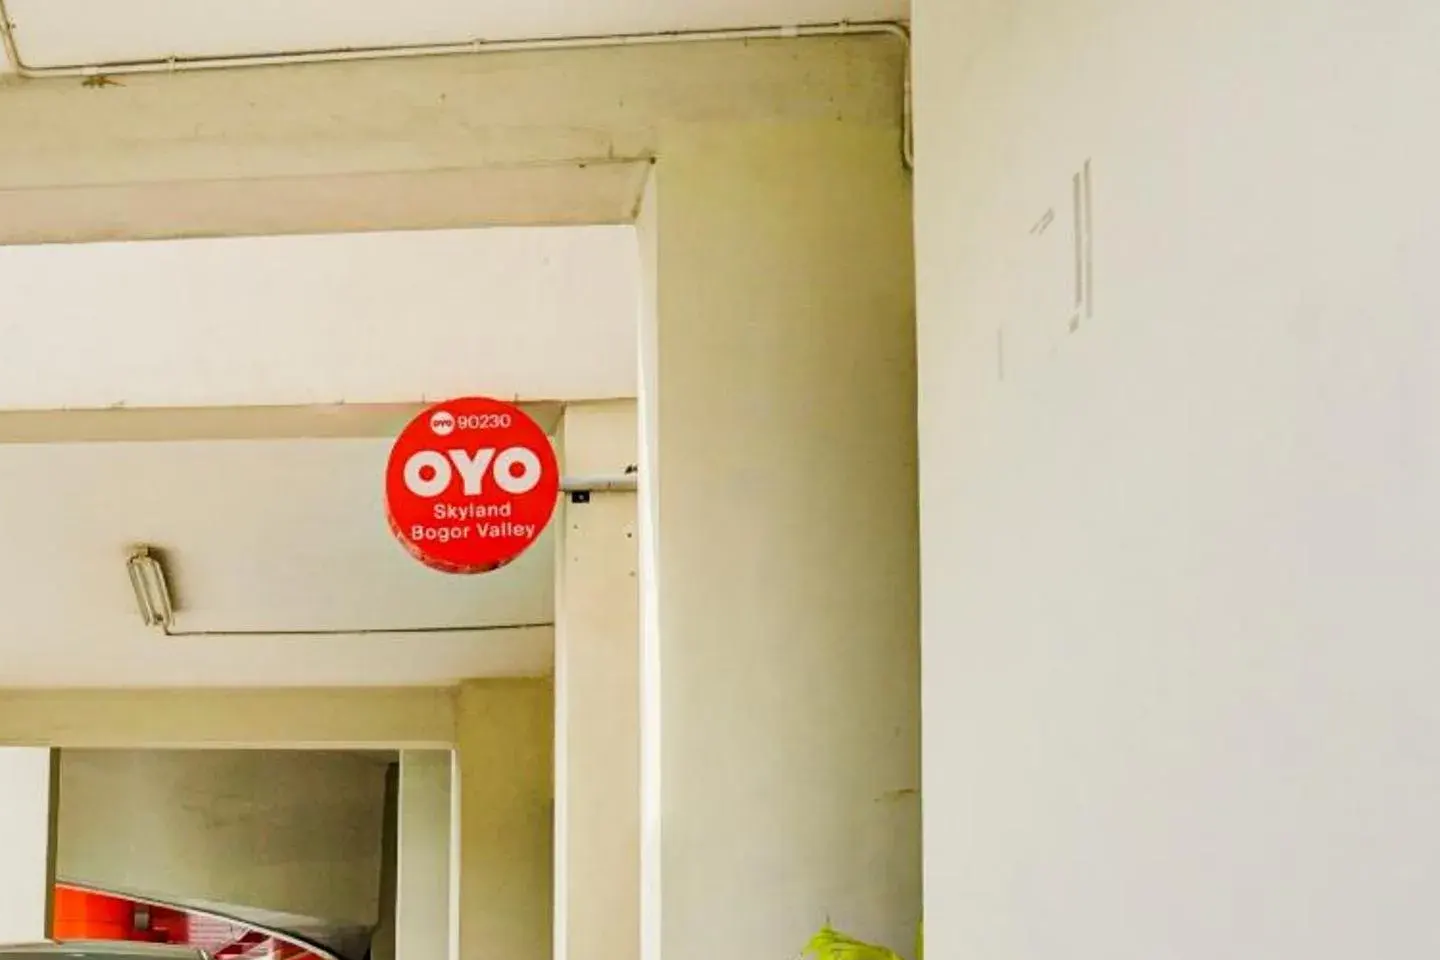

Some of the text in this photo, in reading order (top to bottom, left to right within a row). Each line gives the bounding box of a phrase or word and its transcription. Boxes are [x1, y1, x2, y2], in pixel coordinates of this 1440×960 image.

[458, 414, 511, 429] 90230
[403, 447, 542, 497] OYO
[433, 503, 511, 520] Skyland
[412, 523, 535, 542] Bogor Valley
